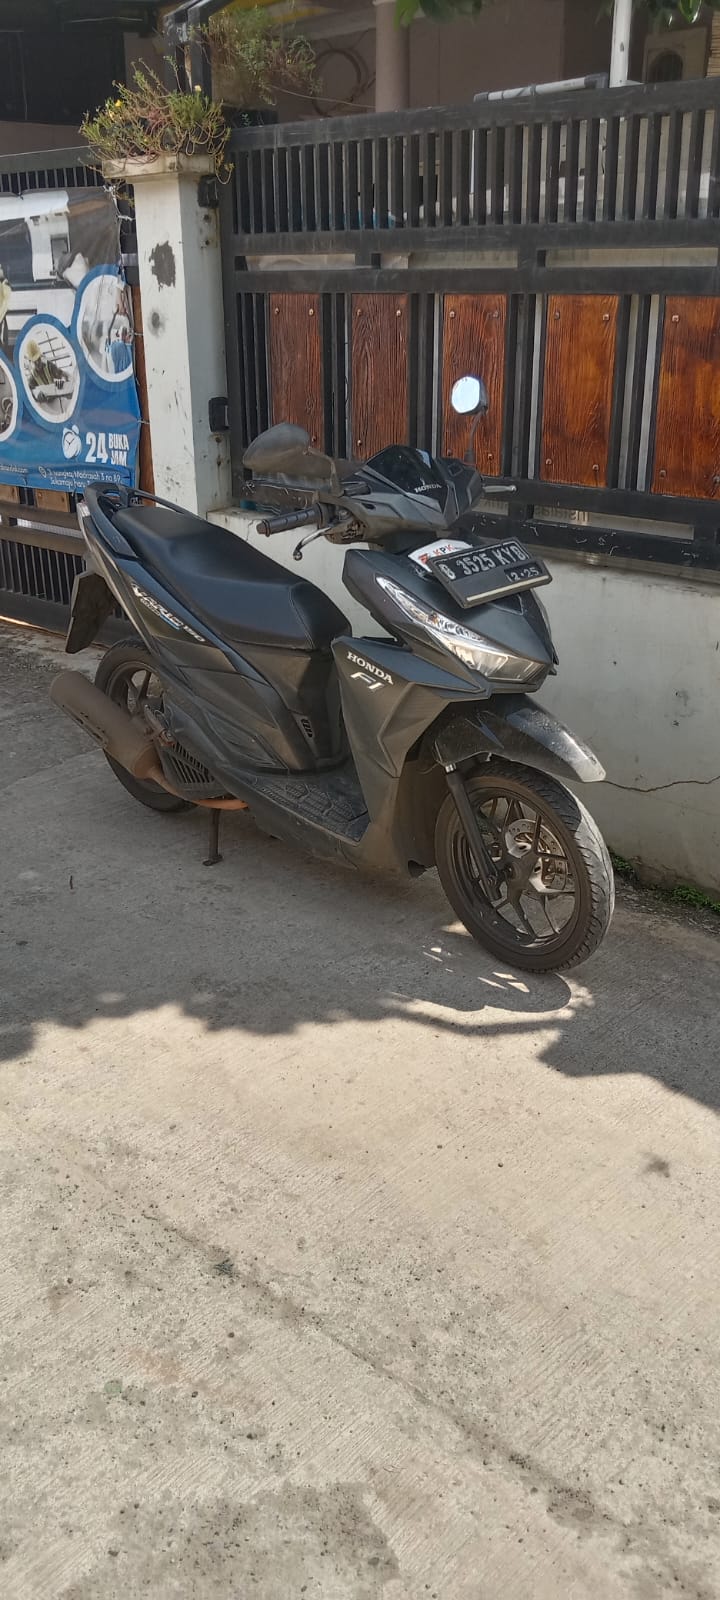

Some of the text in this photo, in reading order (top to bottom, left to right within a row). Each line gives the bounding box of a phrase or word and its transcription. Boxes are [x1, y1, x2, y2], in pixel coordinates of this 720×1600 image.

[86, 432, 129, 464] 24 BUKA
[111, 450, 127, 466] JAM
[414, 484, 442, 493] HONDA
[433, 544, 455, 556] KPK
[439, 564, 456, 580] B
[456, 553, 496, 575] 3525
[346, 651, 394, 685] HONDA
